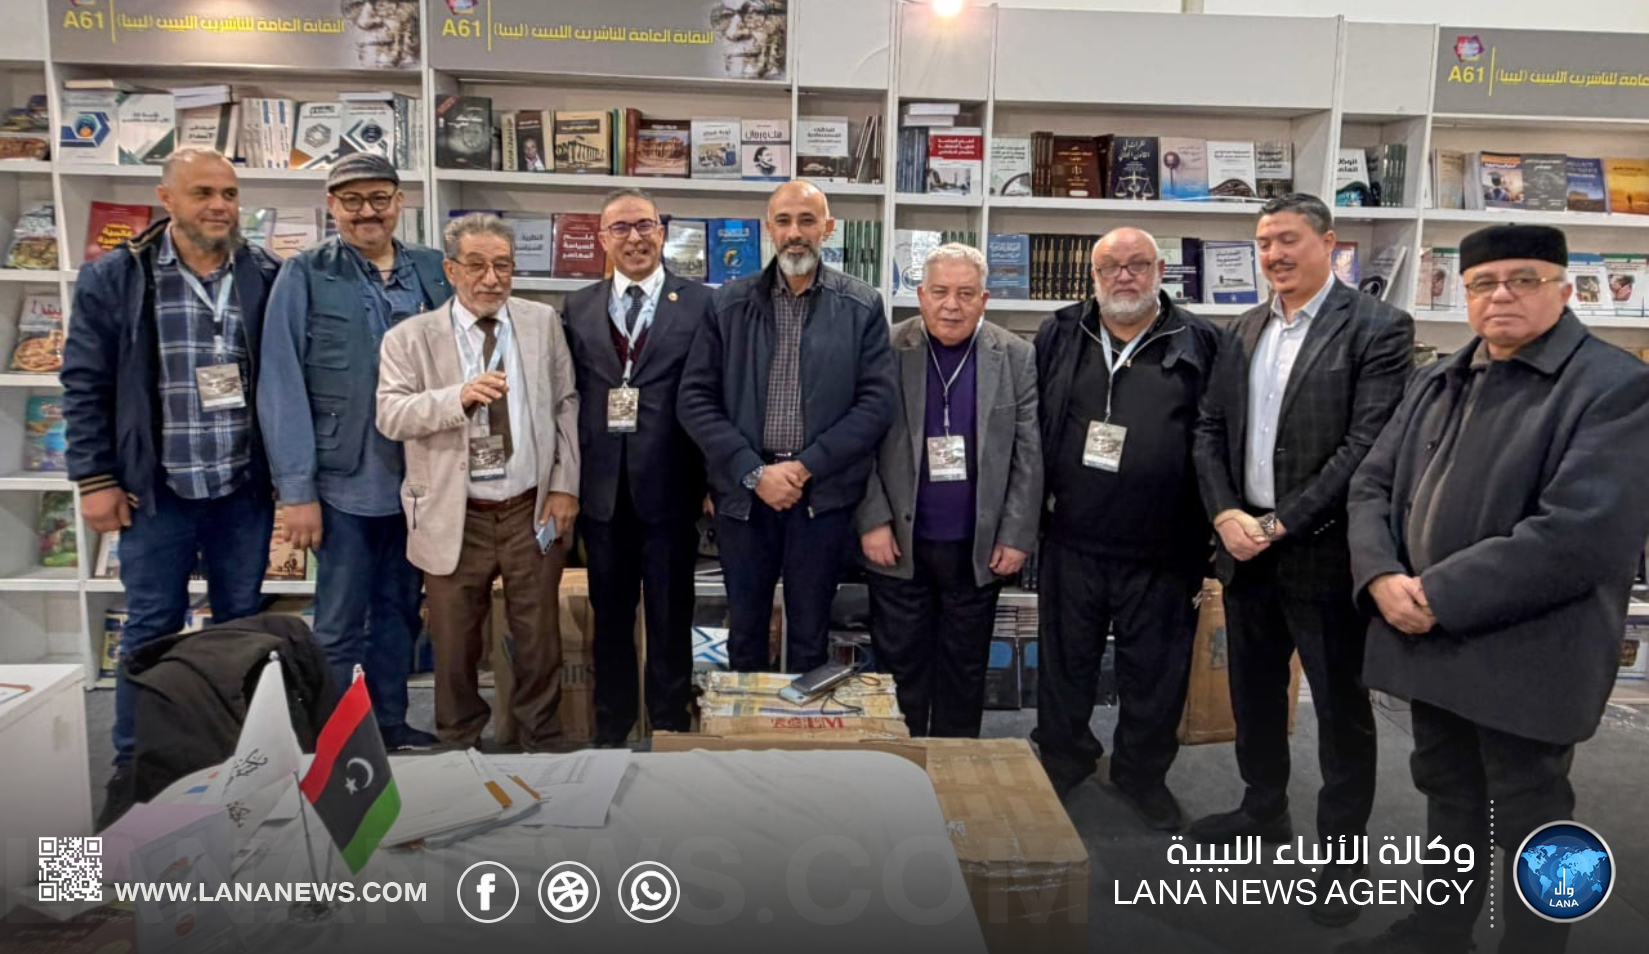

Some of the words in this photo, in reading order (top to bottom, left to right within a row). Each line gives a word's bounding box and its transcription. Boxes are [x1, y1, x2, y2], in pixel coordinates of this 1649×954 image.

[63, 10, 104, 29] A61
[200, 14, 254, 32] للناشرين
[257, 15, 300, 32] العامة
[303, 18, 345, 34] النقابة
[442, 18, 481, 37] A61
[574, 24, 626, 42] للناشرين
[628, 26, 671, 42] العامة
[673, 28, 714, 44] النقابة
[1448, 65, 1485, 83] A61
[1569, 71, 1617, 87] للناشرين
